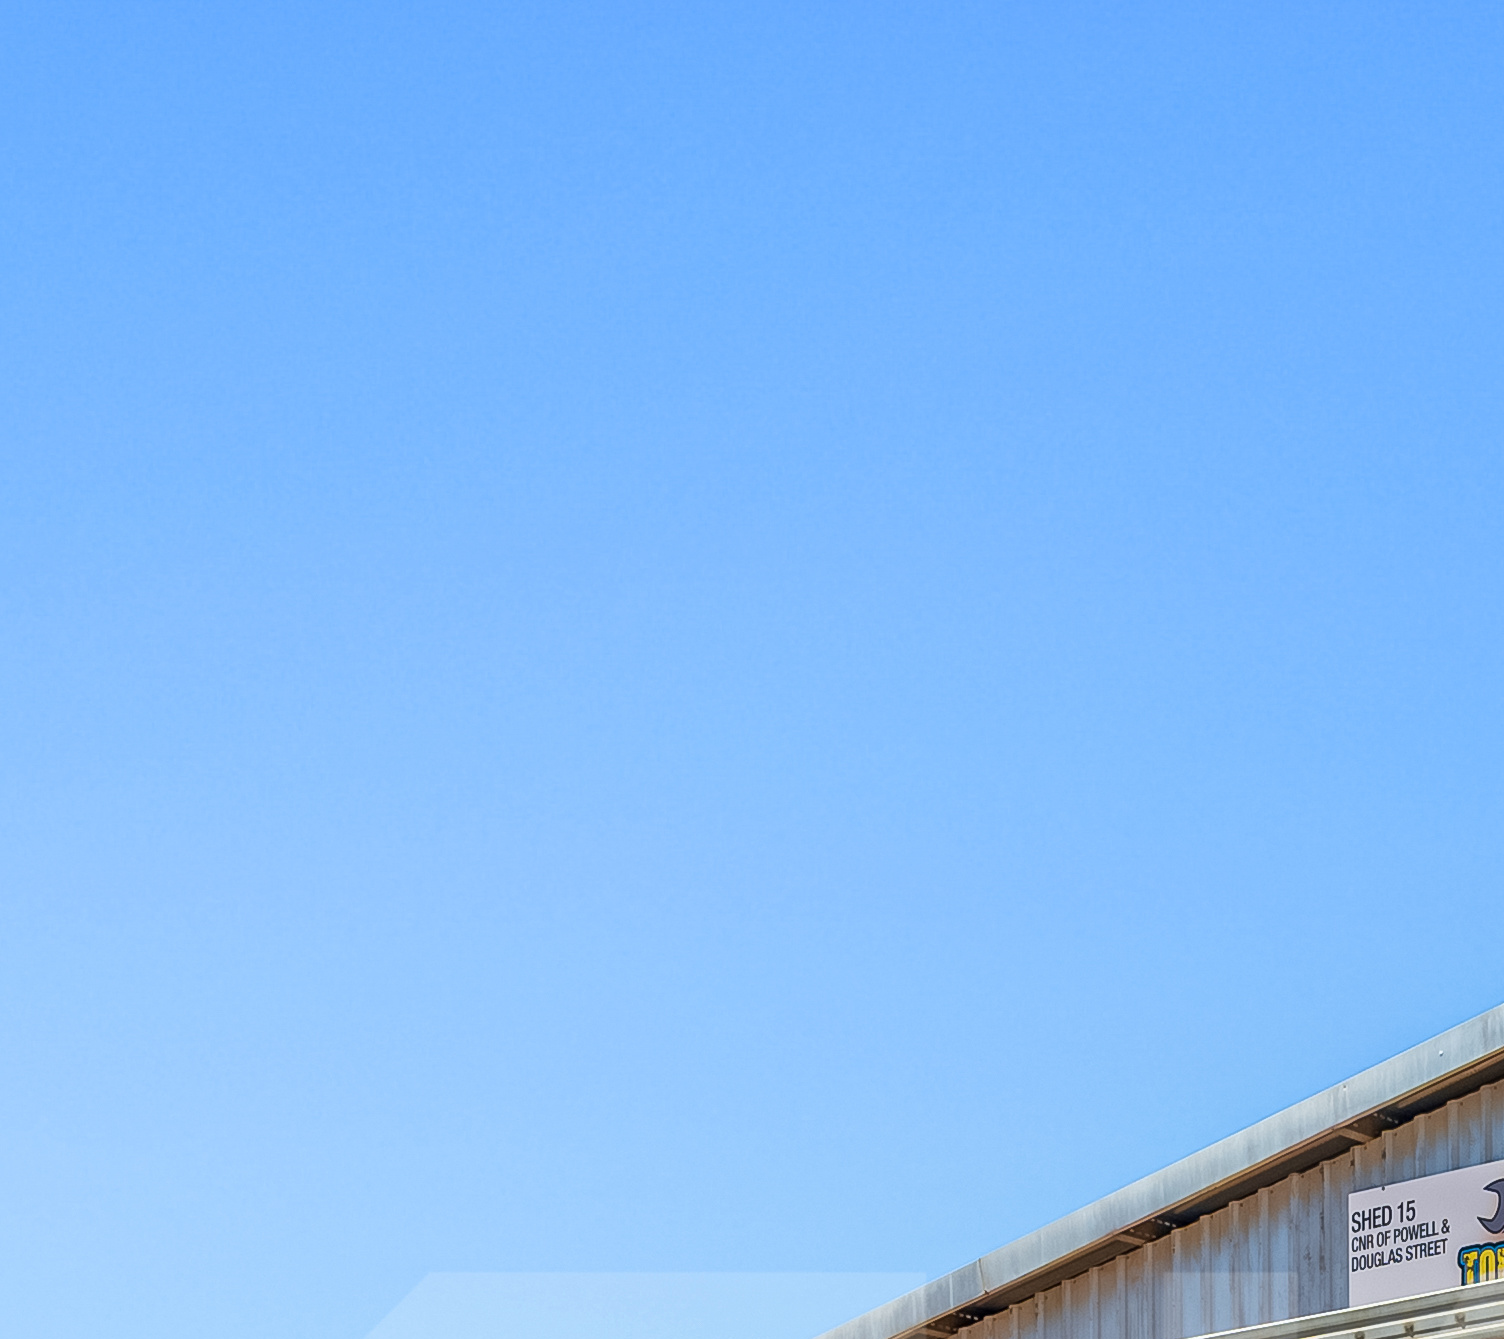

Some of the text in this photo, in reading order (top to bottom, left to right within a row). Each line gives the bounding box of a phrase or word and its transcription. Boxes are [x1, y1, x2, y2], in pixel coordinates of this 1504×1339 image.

[1351, 1199, 1416, 1233] SHED 15
[1351, 1218, 1451, 1253] CNR OF POWELL &
[1351, 1238, 1449, 1273] DOUGLAS STREET
